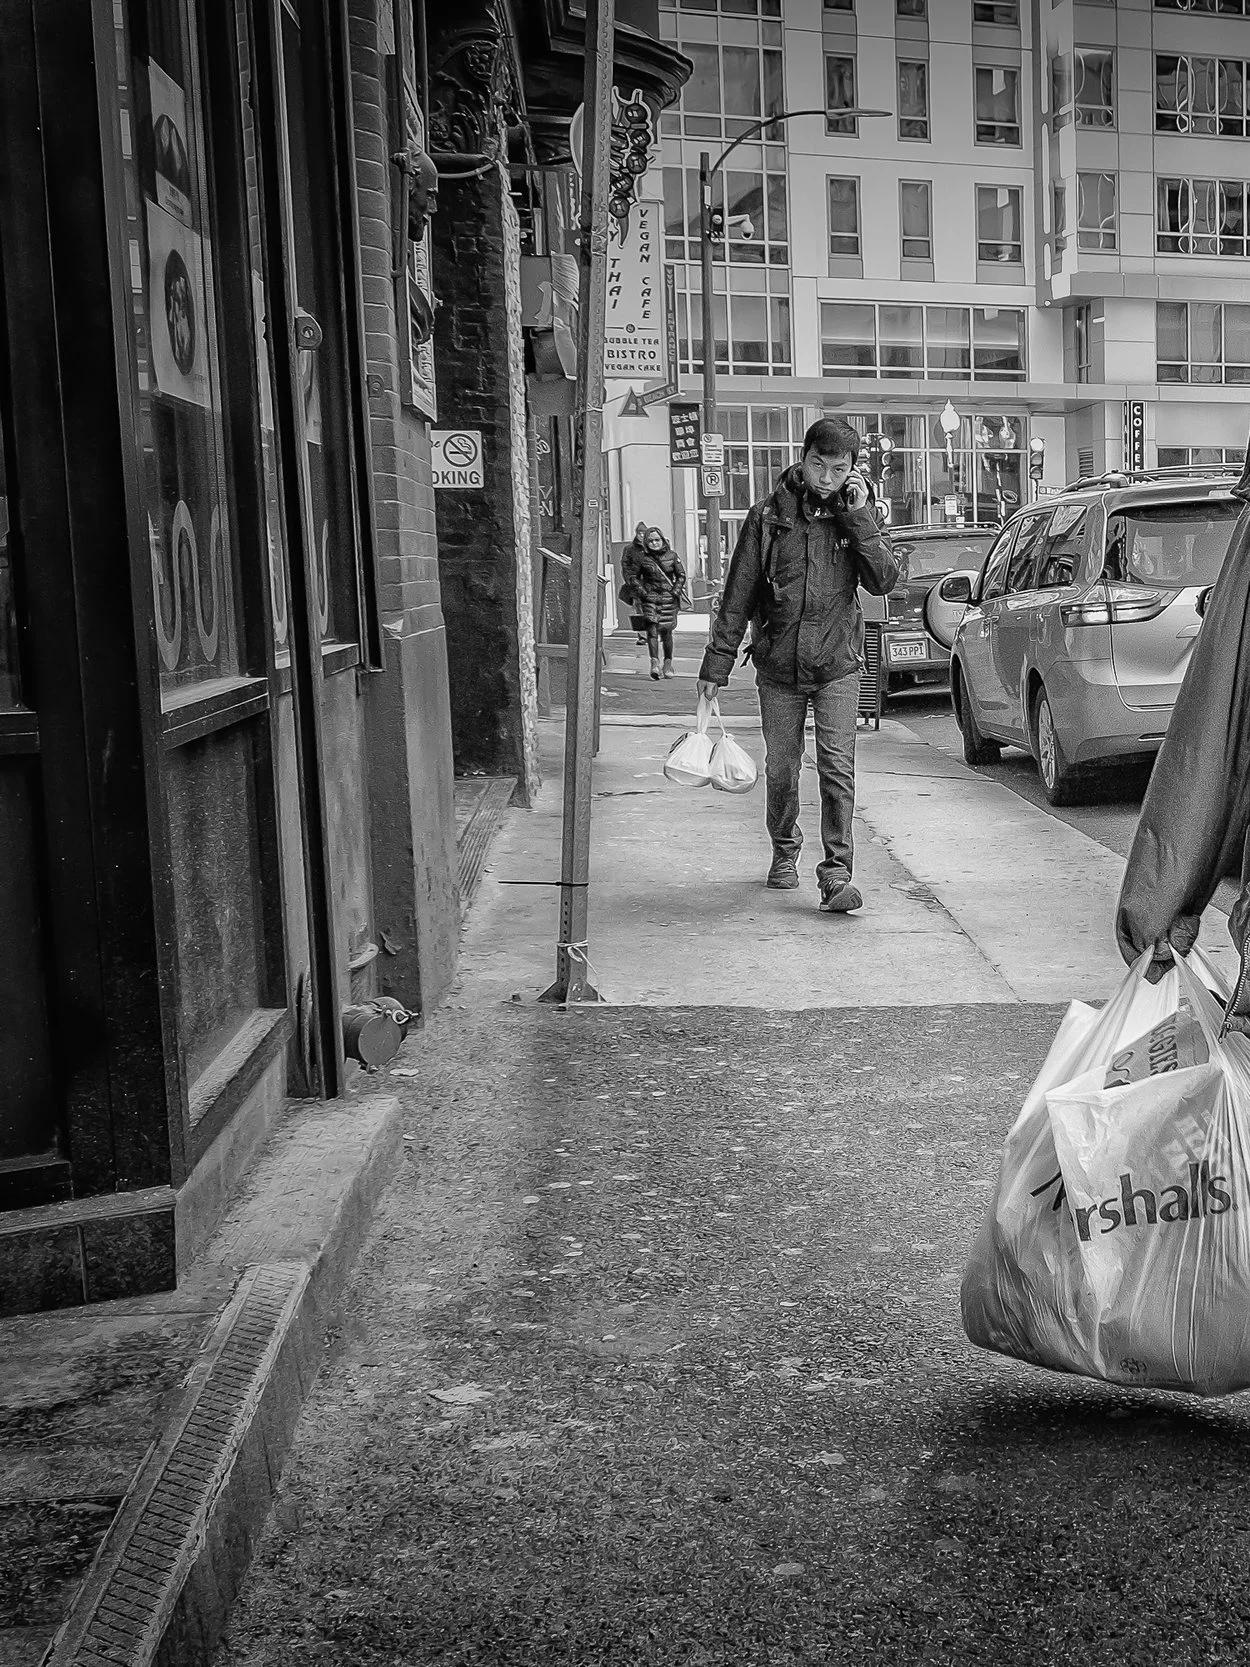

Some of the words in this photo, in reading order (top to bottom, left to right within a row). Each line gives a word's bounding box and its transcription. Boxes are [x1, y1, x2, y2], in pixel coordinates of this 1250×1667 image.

[639, 209, 651, 263] VEGAN
[608, 258, 622, 309] THAI
[641, 276, 652, 319] CAFE
[604, 363, 635, 371] VEGAN
[637, 364, 661, 372] CAKE
[606, 349, 656, 360] BISTRO
[432, 470, 482, 485] OKING
[1030, 1160, 1232, 1241] rshalls
